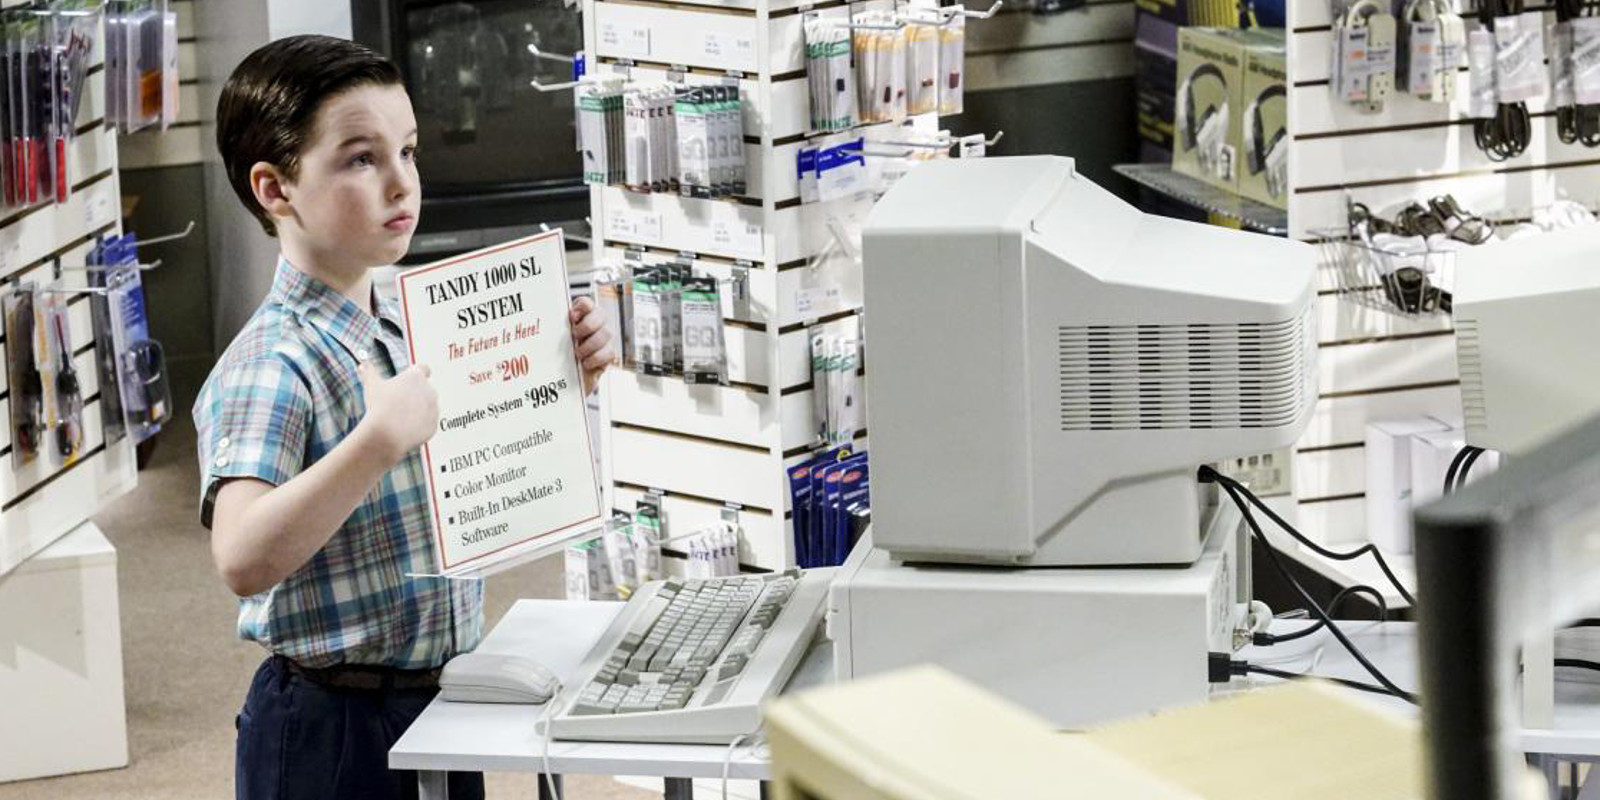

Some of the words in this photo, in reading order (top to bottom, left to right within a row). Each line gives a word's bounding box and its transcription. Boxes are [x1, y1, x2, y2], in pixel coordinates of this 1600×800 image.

[425, 271, 481, 306] TANDY
[484, 261, 517, 290] 1000
[520, 256, 542, 278] SL
[457, 292, 524, 330] SYSTEM
[447, 343, 465, 362] The
[468, 335, 500, 357] Future
[501, 329, 512, 347] Is
[514, 318, 541, 341] Here!
[469, 372, 493, 386] Save
[495, 354, 530, 382] $200
[440, 409, 486, 432] Complete
[487, 398, 524, 419] System
[450, 453, 475, 475] IBM
[475, 446, 491, 466] PC
[492, 428, 554, 460] Compatible
[453, 480, 484, 499] Color
[485, 464, 528, 490] Monitor
[458, 499, 501, 526] Built-In
[502, 483, 554, 512] DeskMate
[555, 477, 564, 493] 3
[461, 521, 510, 547] Software
